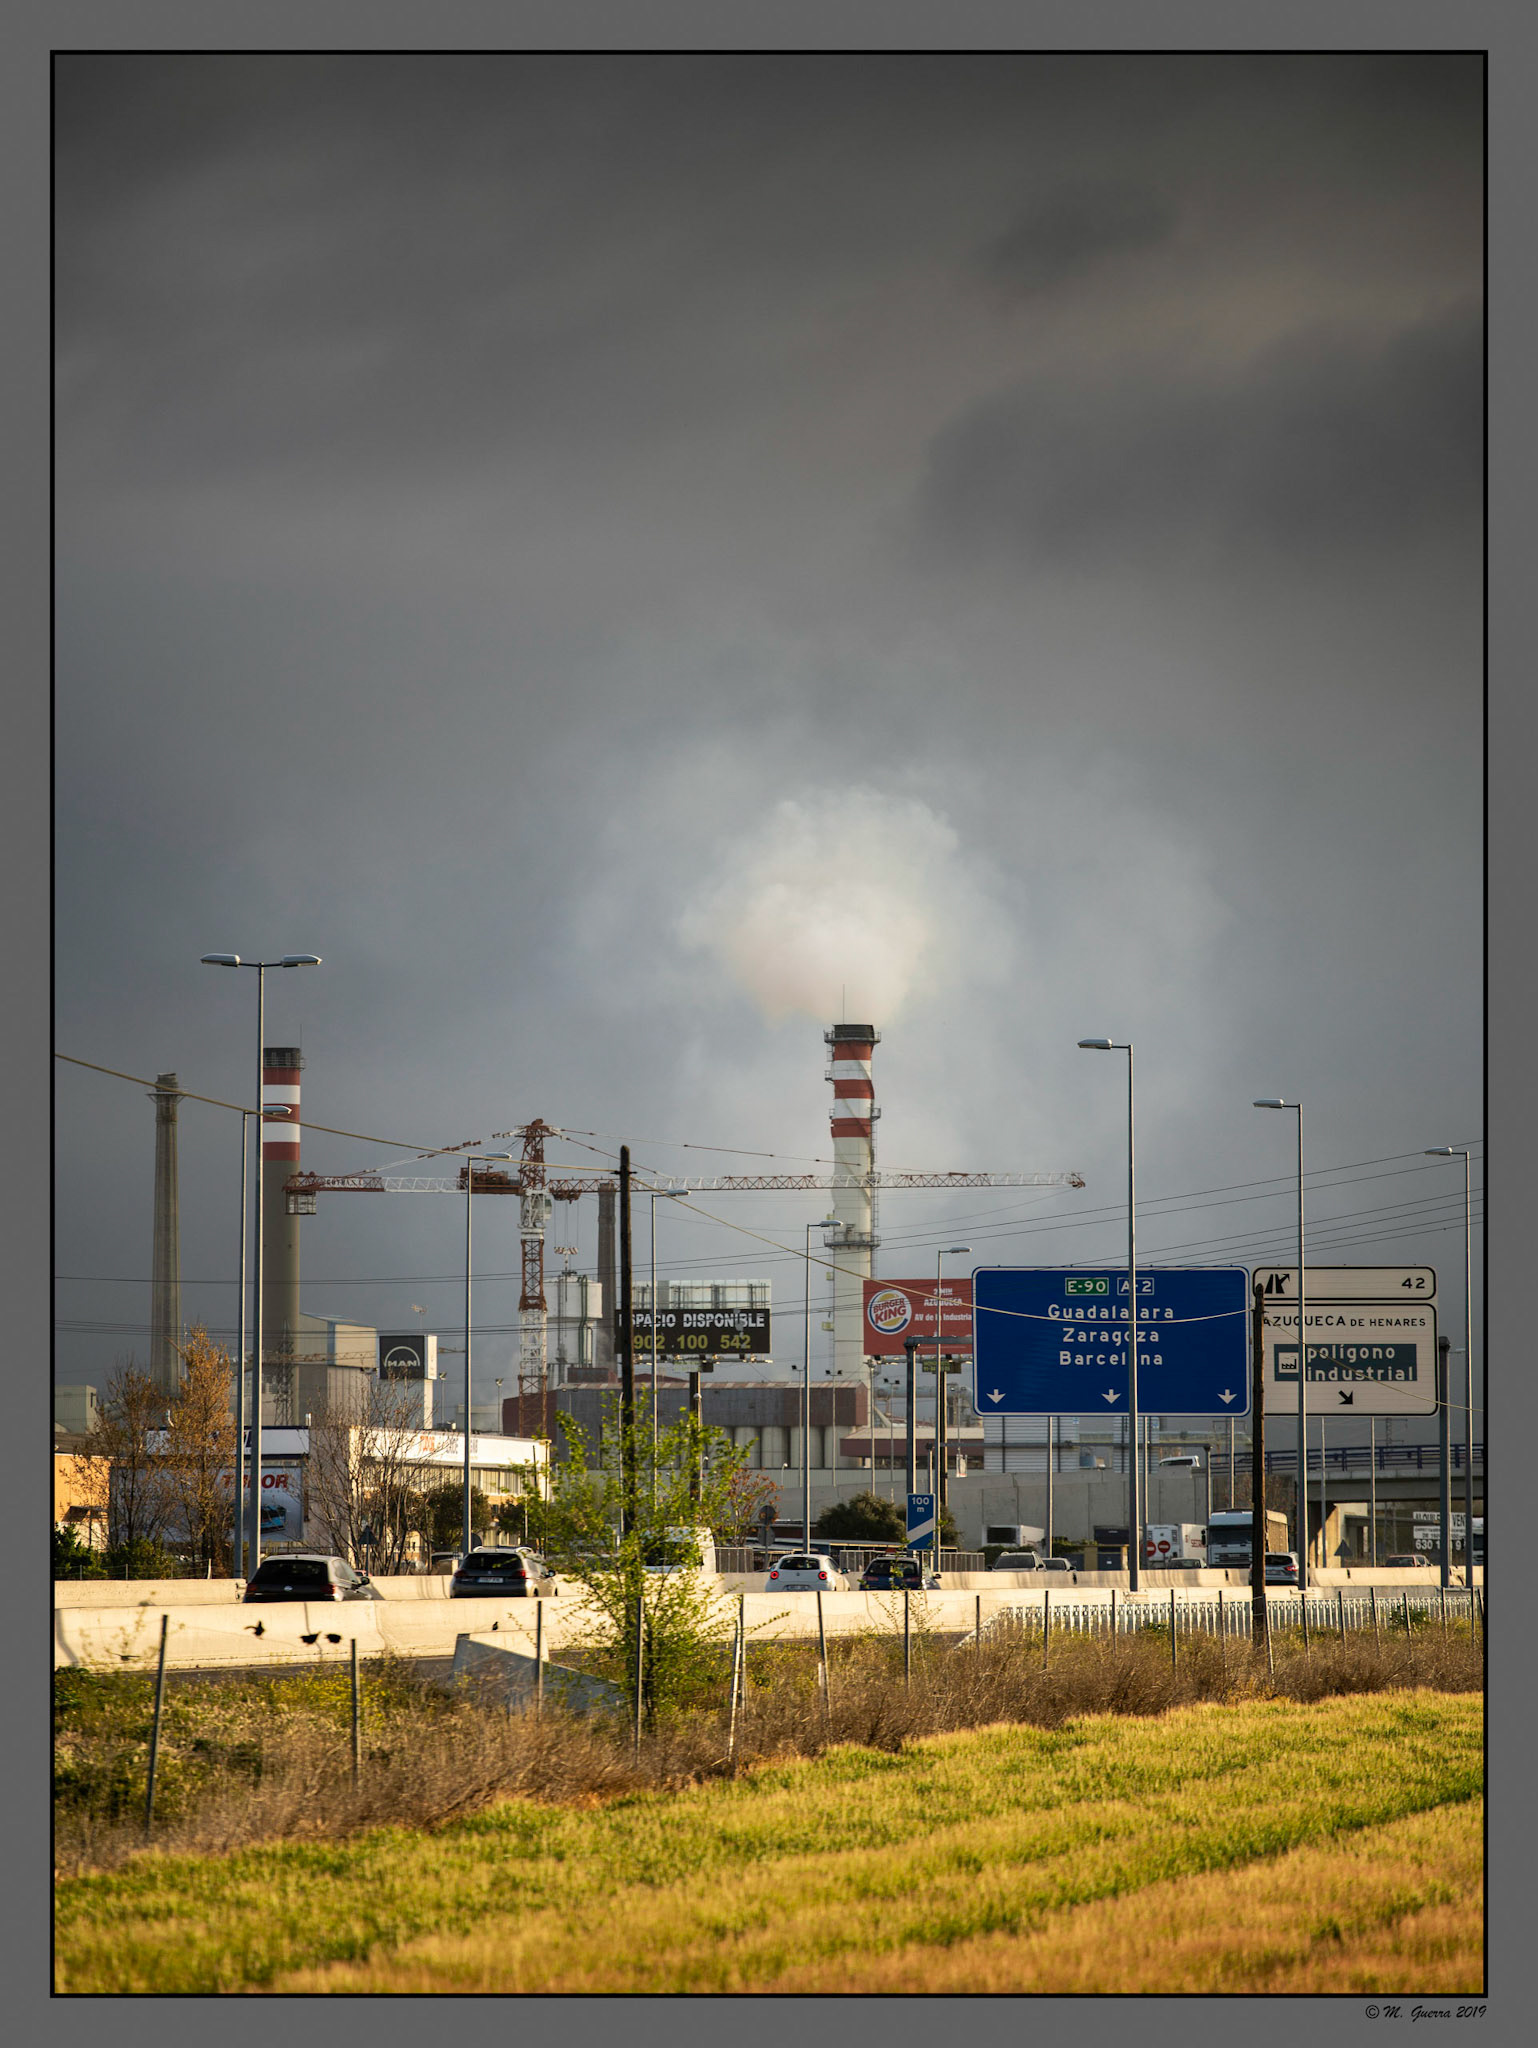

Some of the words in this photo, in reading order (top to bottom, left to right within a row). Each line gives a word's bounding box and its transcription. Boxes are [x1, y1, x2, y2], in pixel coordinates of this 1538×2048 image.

[1068, 1280, 1106, 1292] E-90
[1401, 1277, 1426, 1289] 42
[873, 1298, 905, 1313] BURGER
[1047, 1303, 1174, 1319] Guadalaara
[683, 1313, 765, 1328] DISPONIBLE
[875, 1305, 907, 1324] KING
[925, 1313, 934, 1321] de
[1350, 1318, 1365, 1327] DE
[1369, 1318, 1426, 1327] HENARES
[633, 1334, 665, 1350] 902
[677, 1334, 708, 1350] 100
[719, 1334, 752, 1350] 542
[1059, 1350, 1163, 1366] Barcelna
[1307, 1344, 1396, 1363] polígono
[1307, 1366, 1413, 1381] industrial
[911, 1497, 930, 1505] 100
[1415, 1539, 1433, 1550] 630
